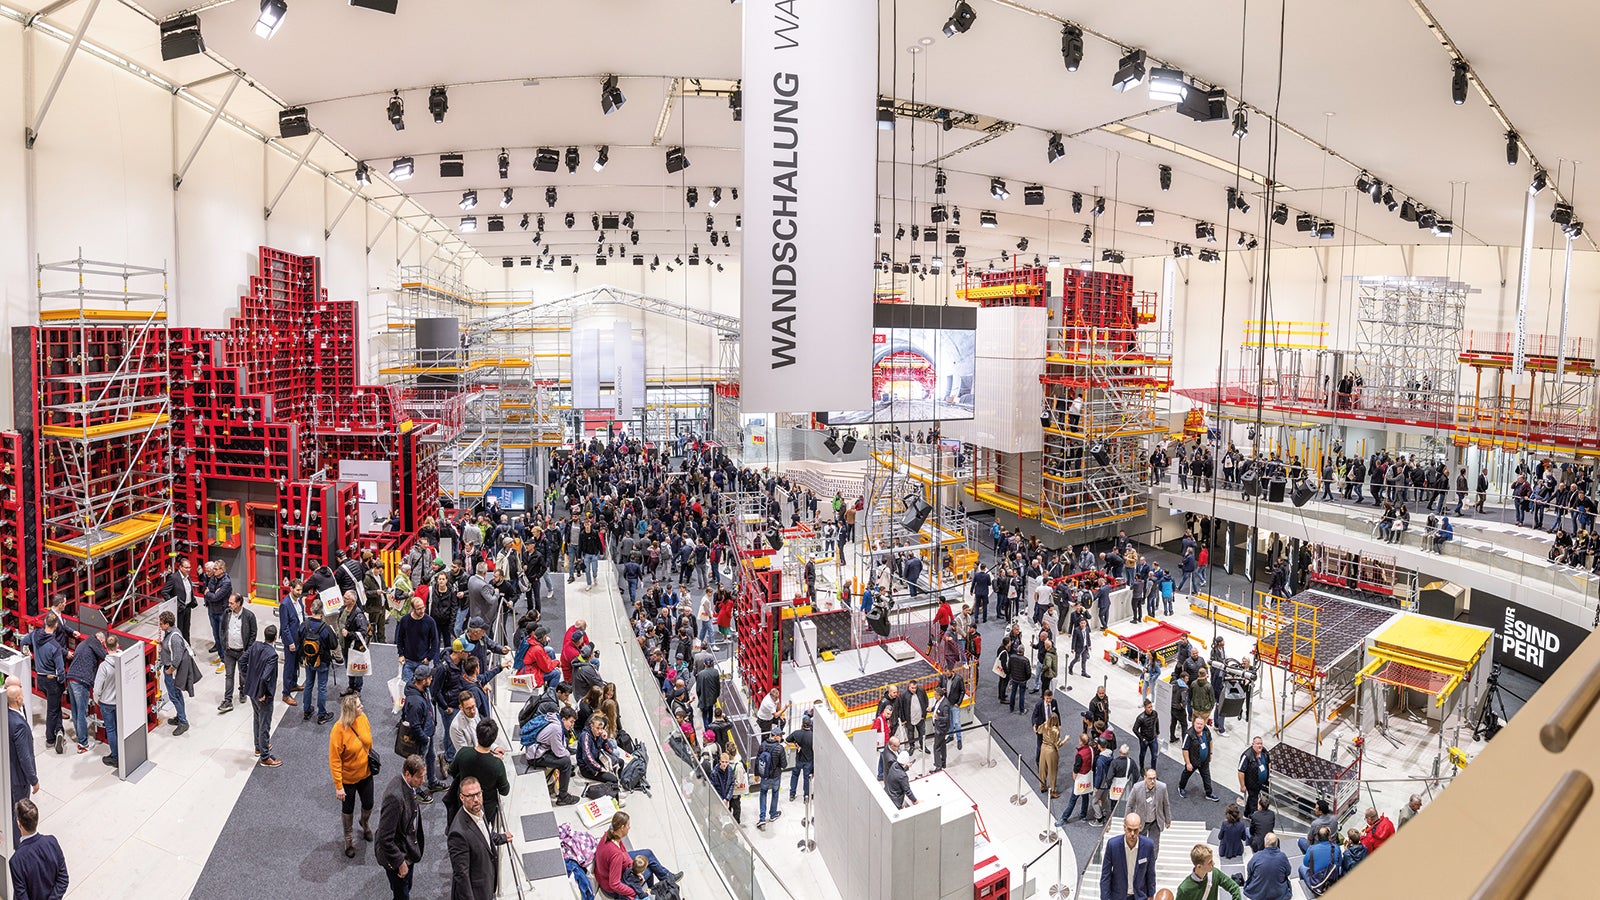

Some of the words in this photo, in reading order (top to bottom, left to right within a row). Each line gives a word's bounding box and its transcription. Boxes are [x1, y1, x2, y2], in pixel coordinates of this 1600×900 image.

[771, 72, 799, 369] WANDSCHALUNG
[753, 435, 765, 443] PERI
[1504, 606, 1516, 636] WIR
[1513, 619, 1560, 653] SIND
[353, 662, 368, 671] PERI
[1502, 634, 1545, 669] PERI
[588, 801, 602, 819] PERI
